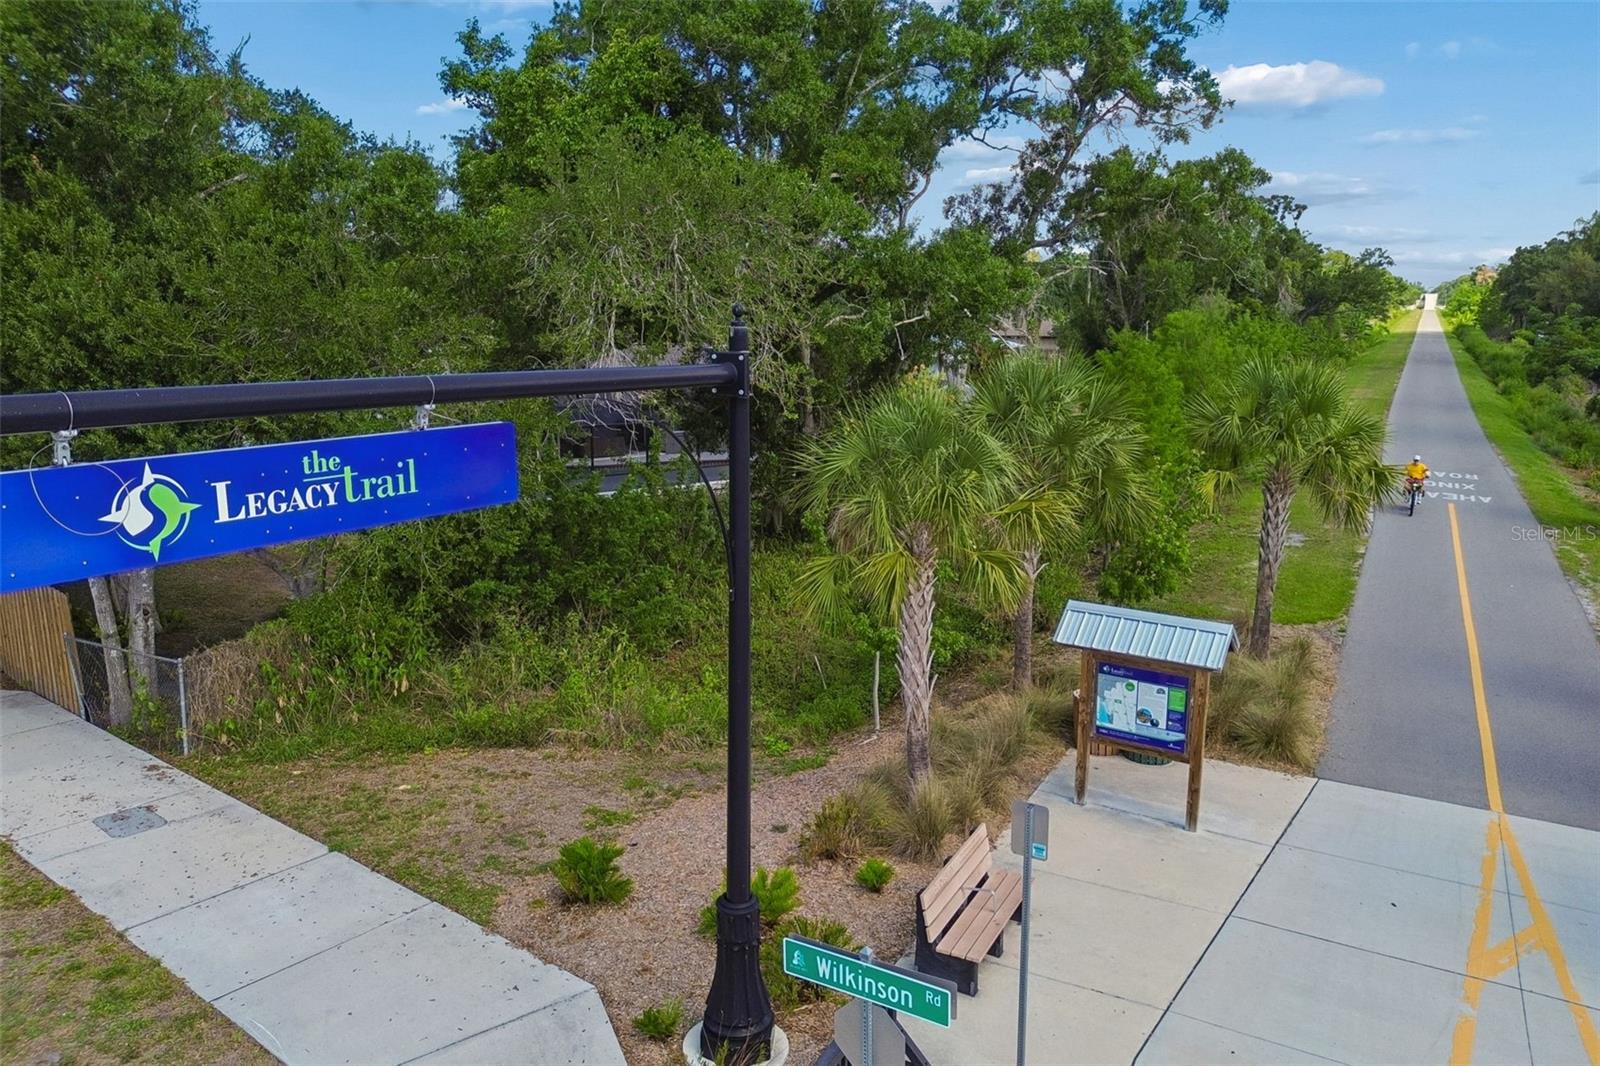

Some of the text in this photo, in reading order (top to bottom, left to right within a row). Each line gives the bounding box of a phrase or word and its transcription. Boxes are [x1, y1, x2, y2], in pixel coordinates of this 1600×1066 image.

[302, 450, 341, 474] the
[1433, 471, 1479, 480] ROA
[211, 458, 419, 523] LEGACY trail
[1426, 491, 1492, 503] AHEA
[817, 956, 941, 1008] Wilkinson Rd
